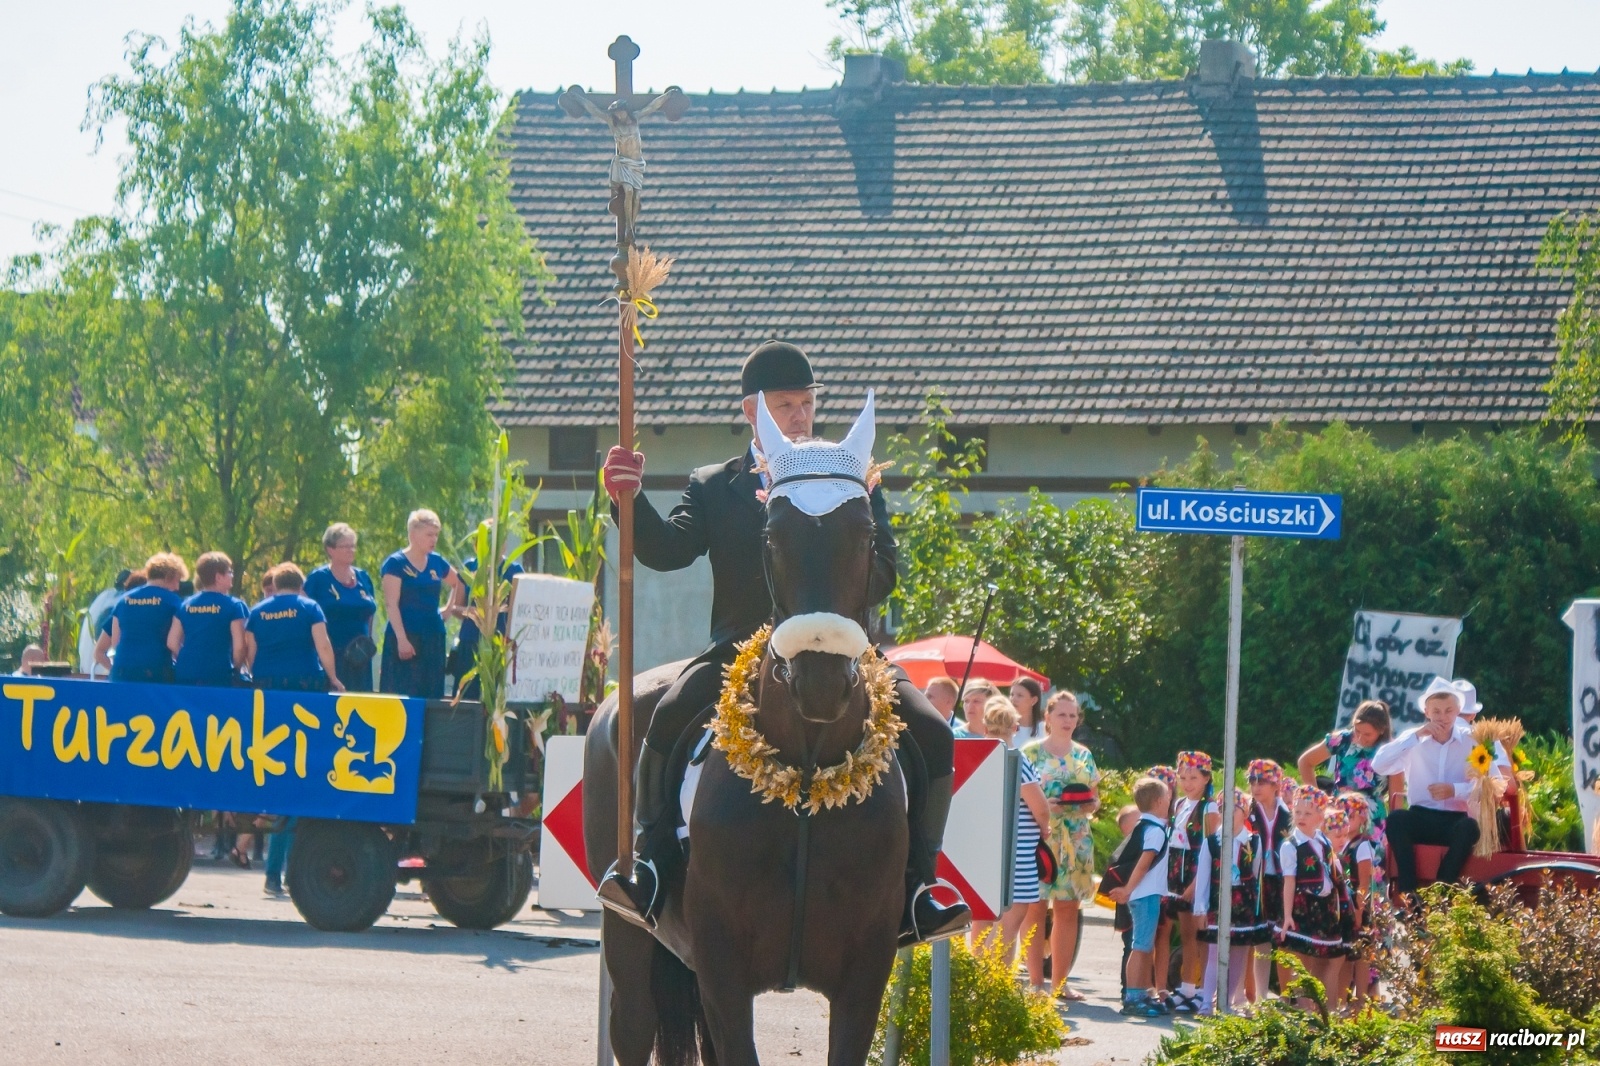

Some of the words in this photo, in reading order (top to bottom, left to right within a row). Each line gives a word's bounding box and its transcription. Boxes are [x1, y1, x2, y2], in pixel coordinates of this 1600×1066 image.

[1148, 499, 1176, 521] ul.
[1180, 499, 1316, 526] Kościuszki
[124, 596, 162, 606] Turzanki
[185, 604, 222, 614] Turzanki
[260, 608, 299, 621] Turzanki
[1375, 619, 1413, 668] gór
[3, 684, 321, 787] Turzanki
